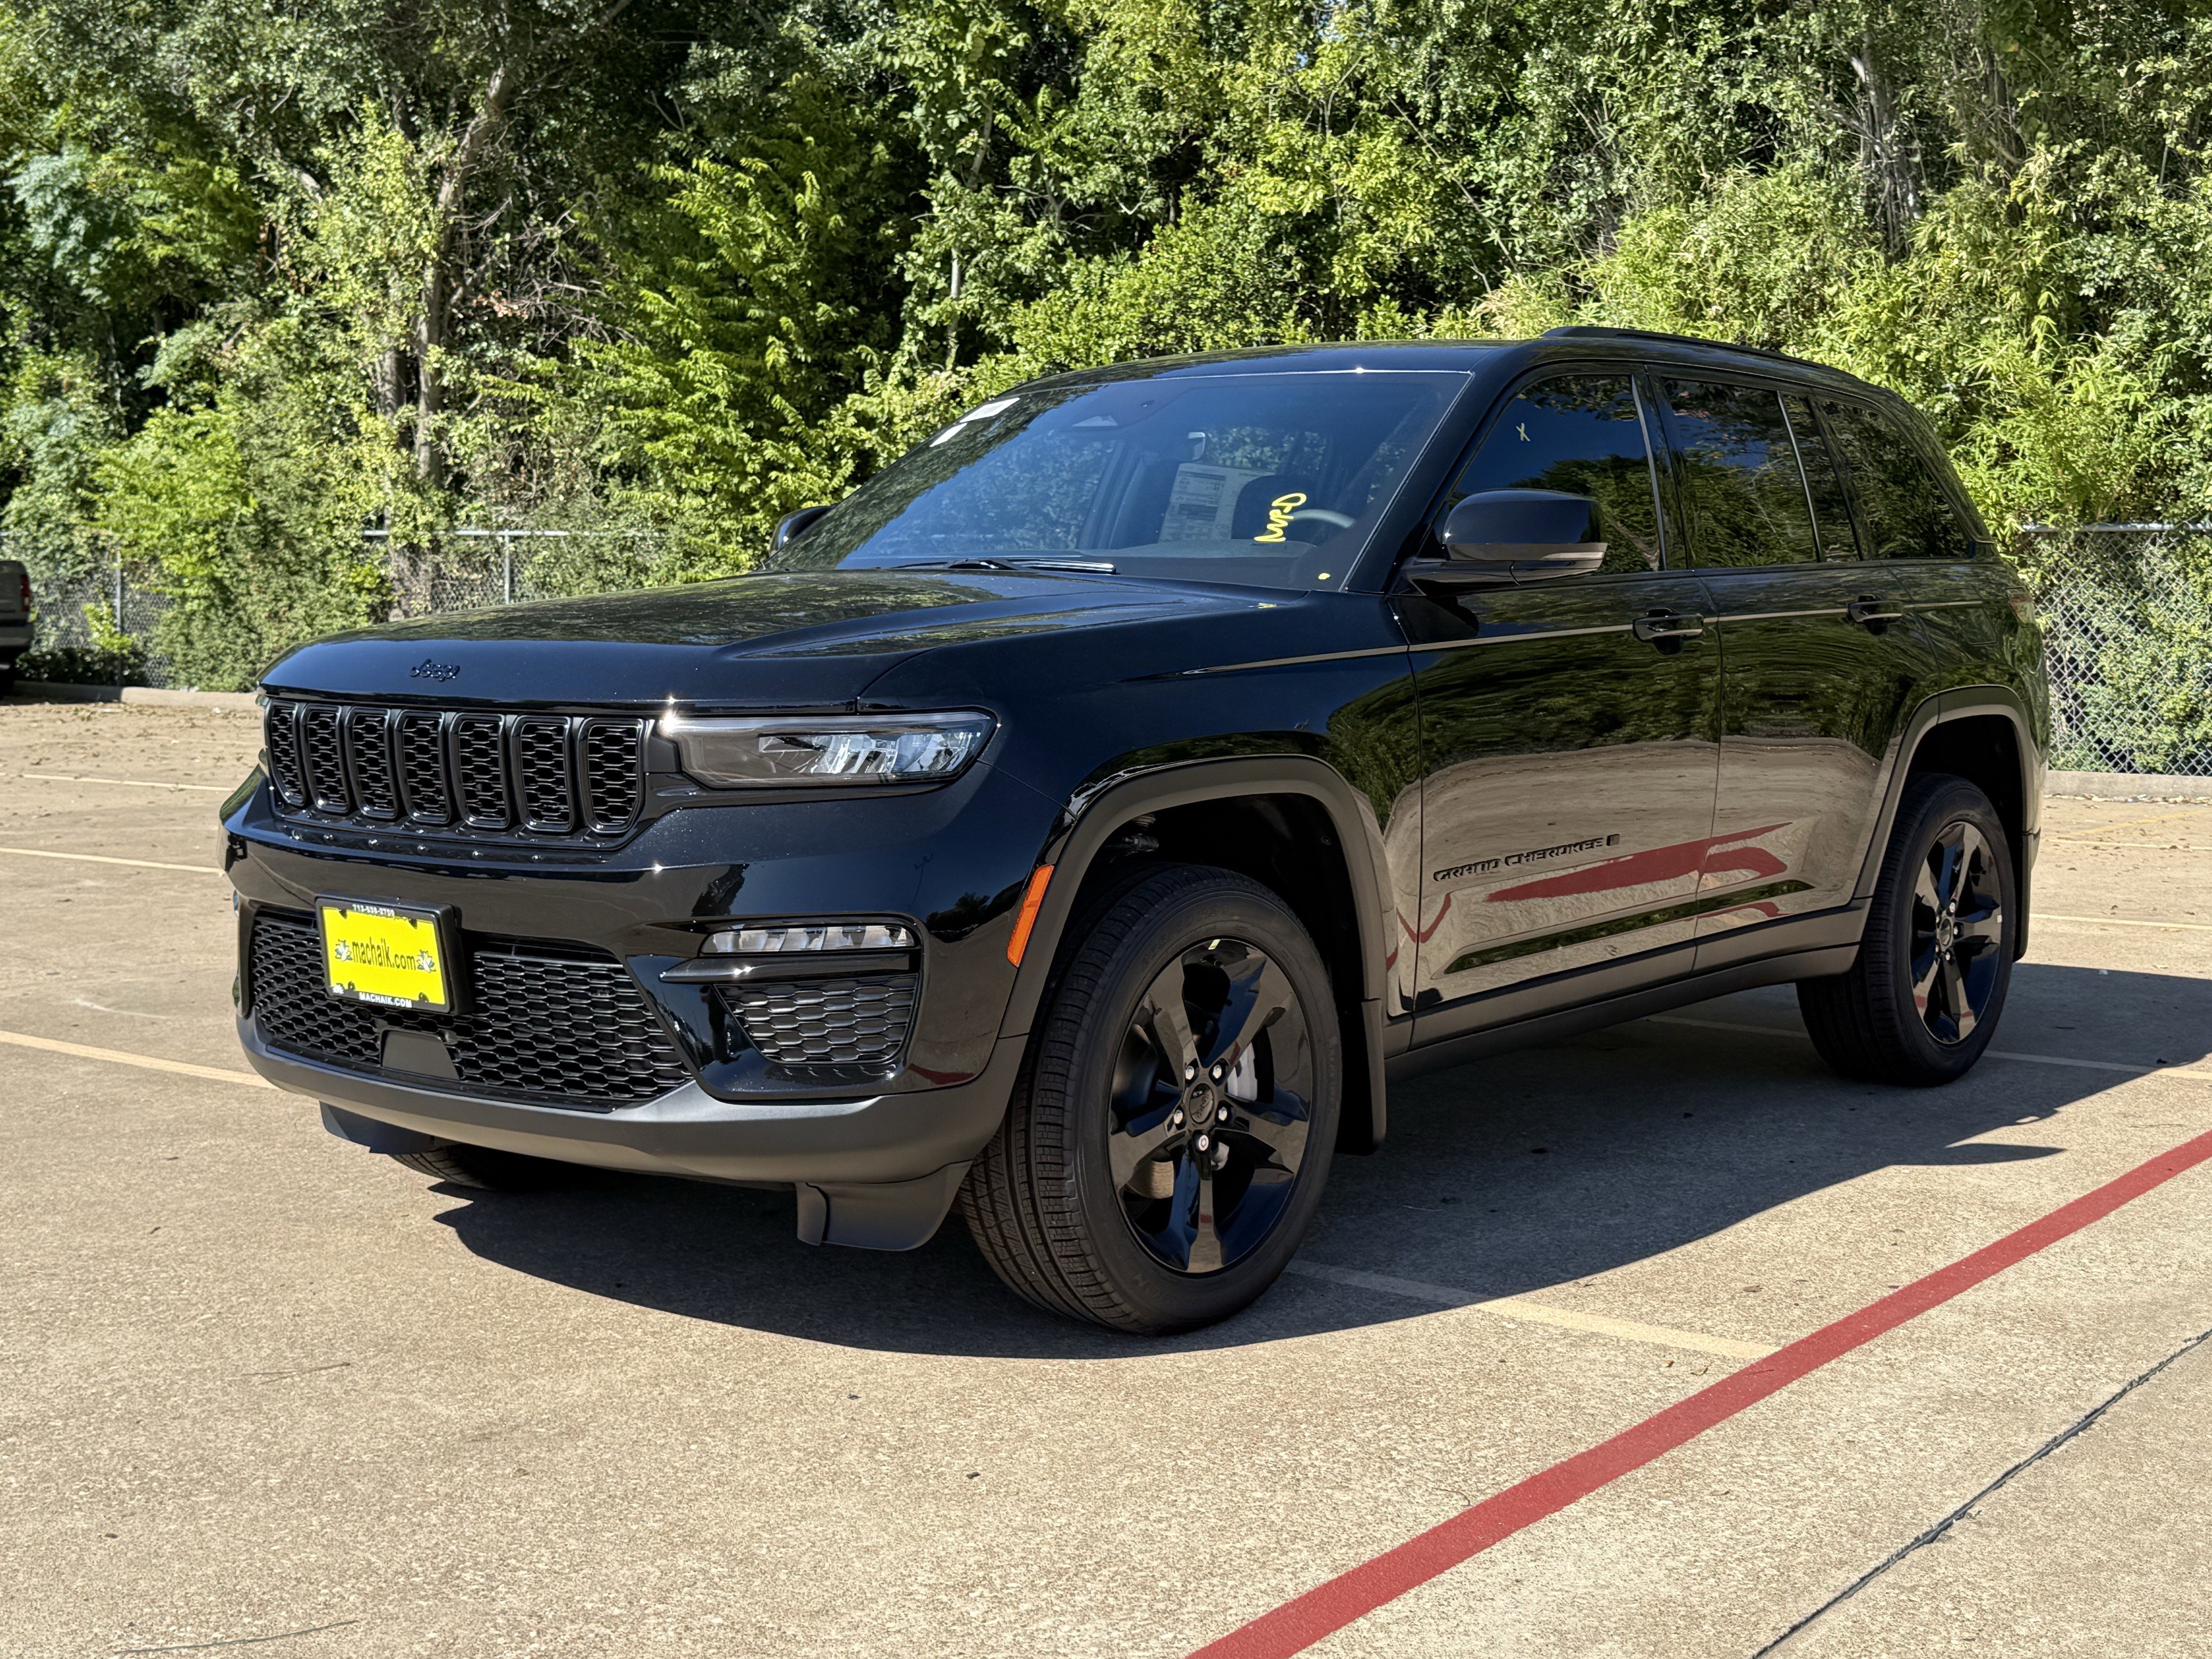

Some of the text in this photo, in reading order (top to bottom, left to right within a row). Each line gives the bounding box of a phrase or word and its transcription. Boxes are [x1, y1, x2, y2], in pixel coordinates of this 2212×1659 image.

[1433, 837, 1603, 882] GRAND CHEROKEE
[352, 936, 416, 970] machaik.com
[359, 991, 412, 1008] MACHAIK.COM
